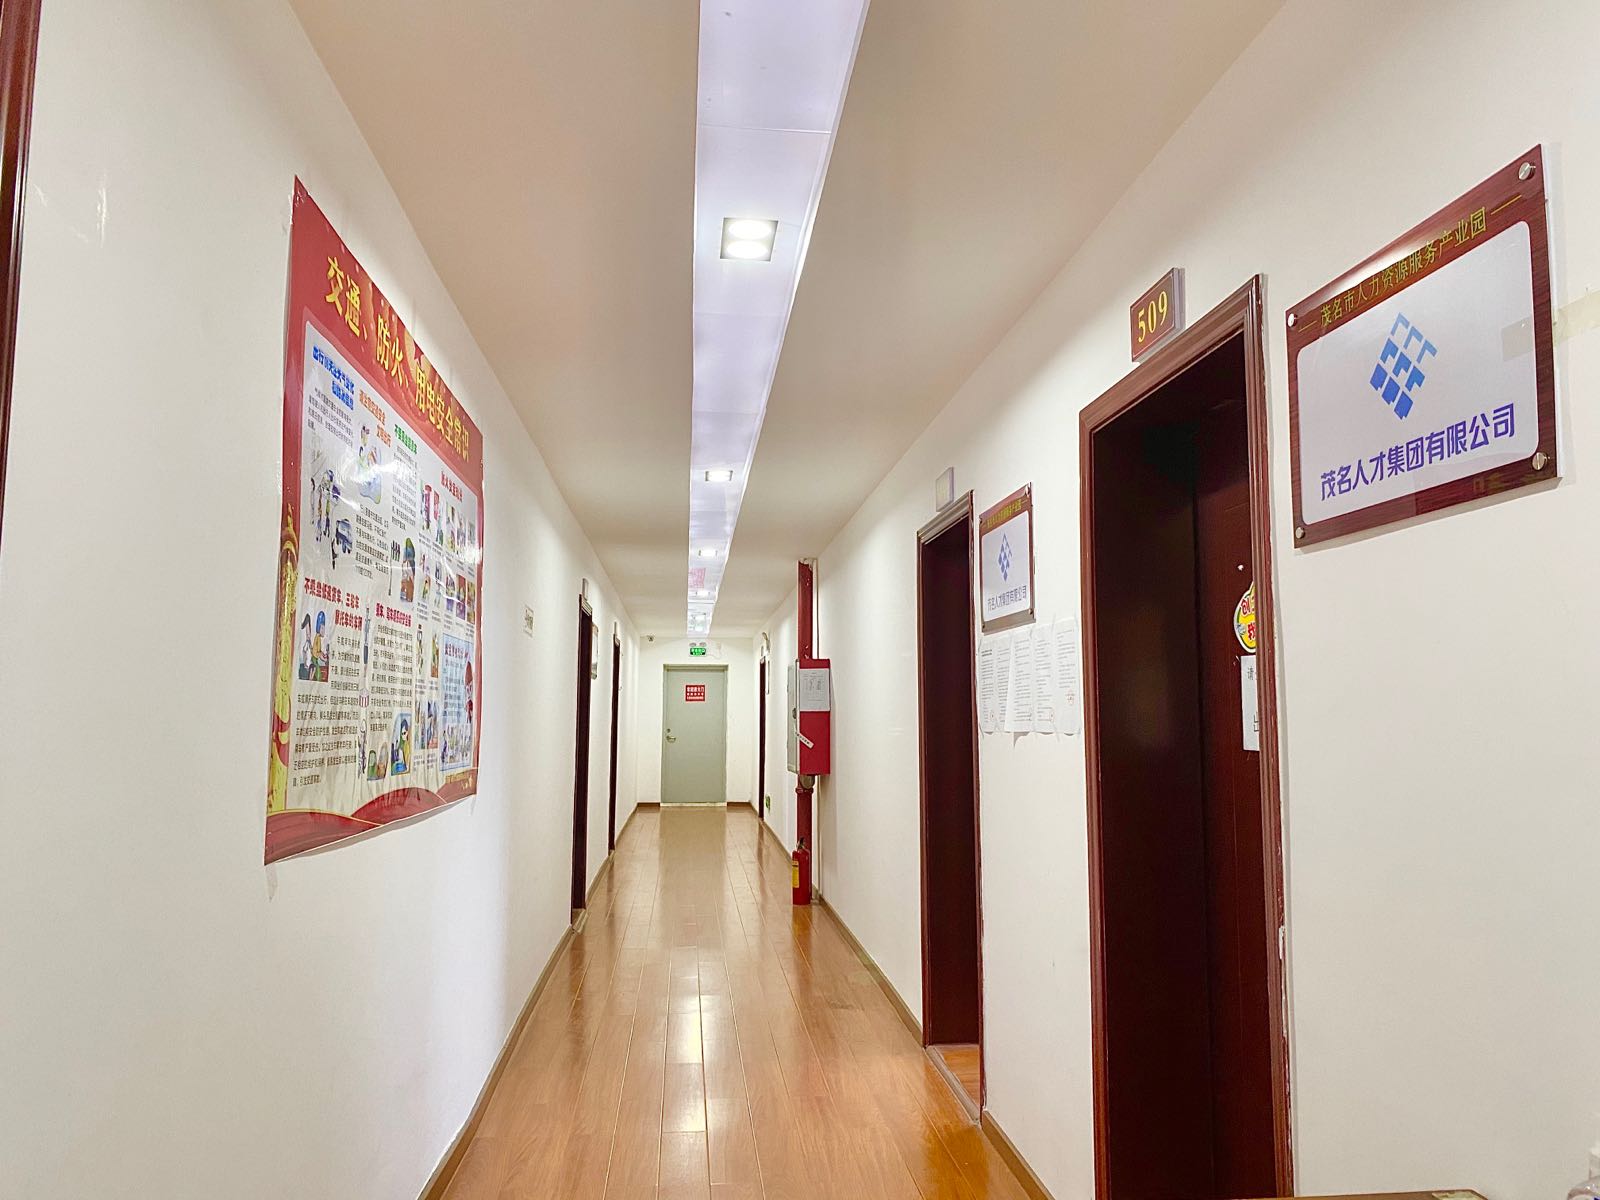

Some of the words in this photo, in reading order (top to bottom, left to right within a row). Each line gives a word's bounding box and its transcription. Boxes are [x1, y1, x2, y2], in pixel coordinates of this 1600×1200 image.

[1320, 206, 1487, 328] 茂名市人力资源服务产业园
[1138, 291, 1168, 343] 509
[1321, 403, 1515, 501] 茂名人才集团有限公司
